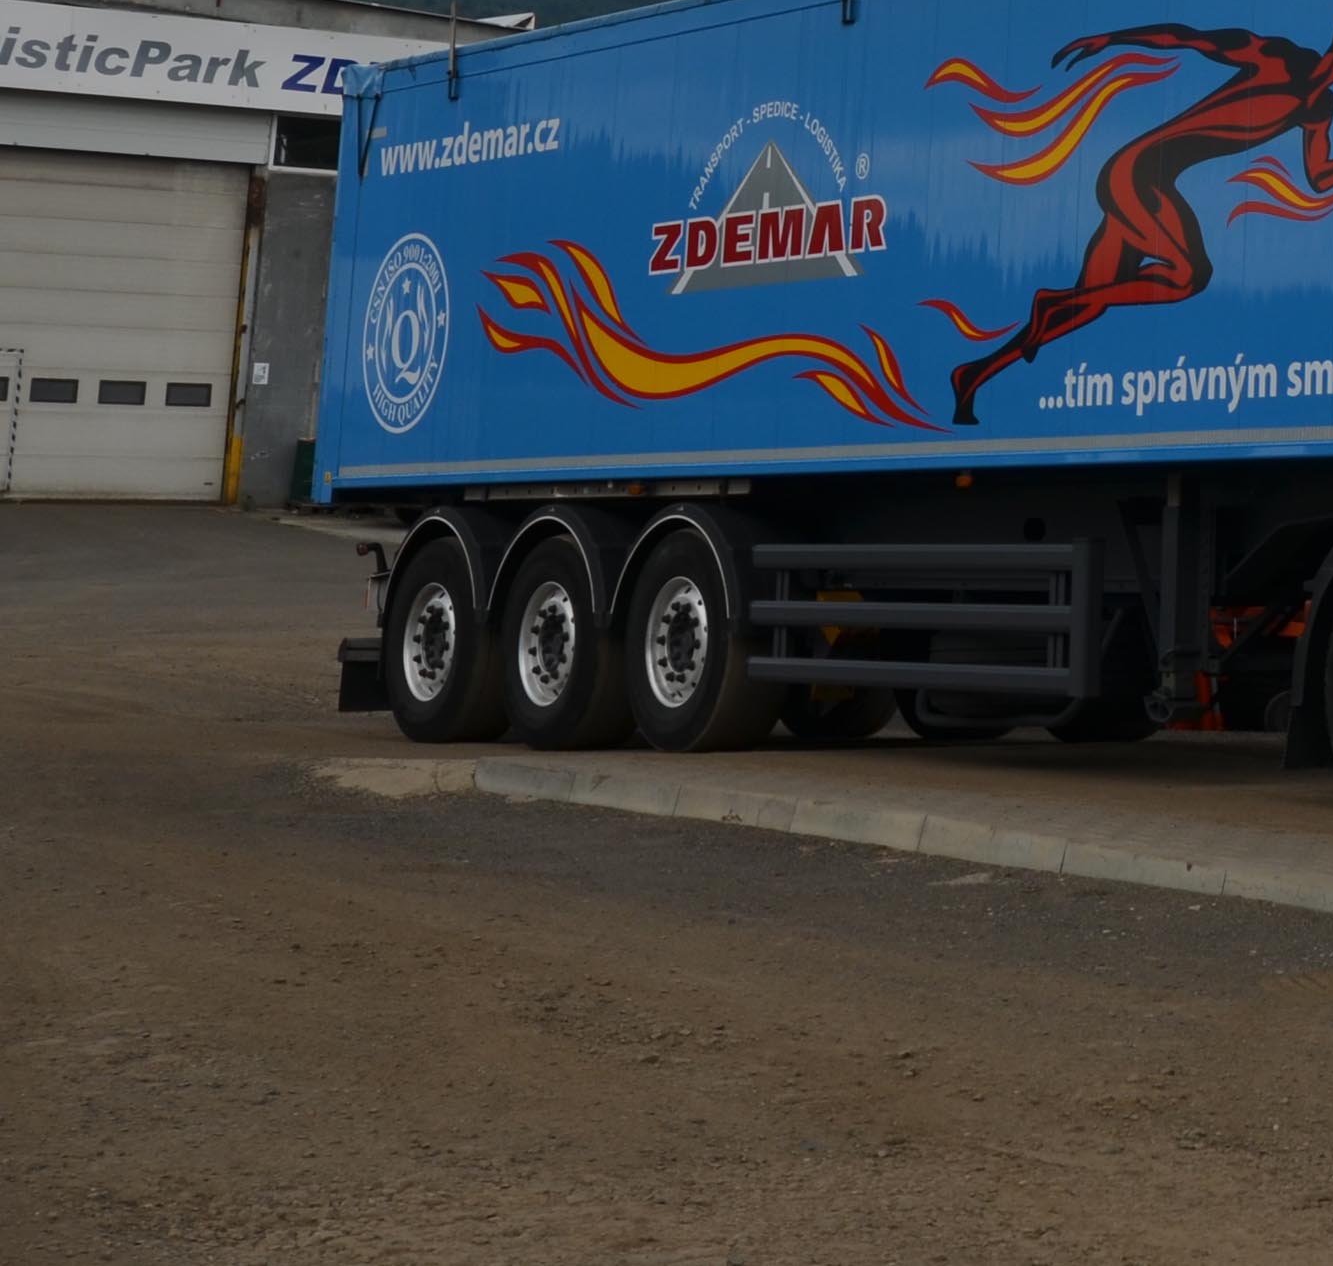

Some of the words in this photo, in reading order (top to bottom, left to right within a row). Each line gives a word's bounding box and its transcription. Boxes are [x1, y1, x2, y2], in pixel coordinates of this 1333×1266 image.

[381, 118, 561, 176] www.zdemar.cz
[689, 117, 745, 211] TRANSPORT
[752, 101, 799, 124] SPEDICE
[804, 112, 848, 192] LOGISTIKA
[384, 251, 402, 283] ISO
[648, 194, 888, 276] ZDEMAR
[372, 383, 396, 423] HIGH
[397, 354, 438, 426] QUALITY
[1039, 362, 1113, 409] ...tím
[1121, 353, 1277, 416] správným
